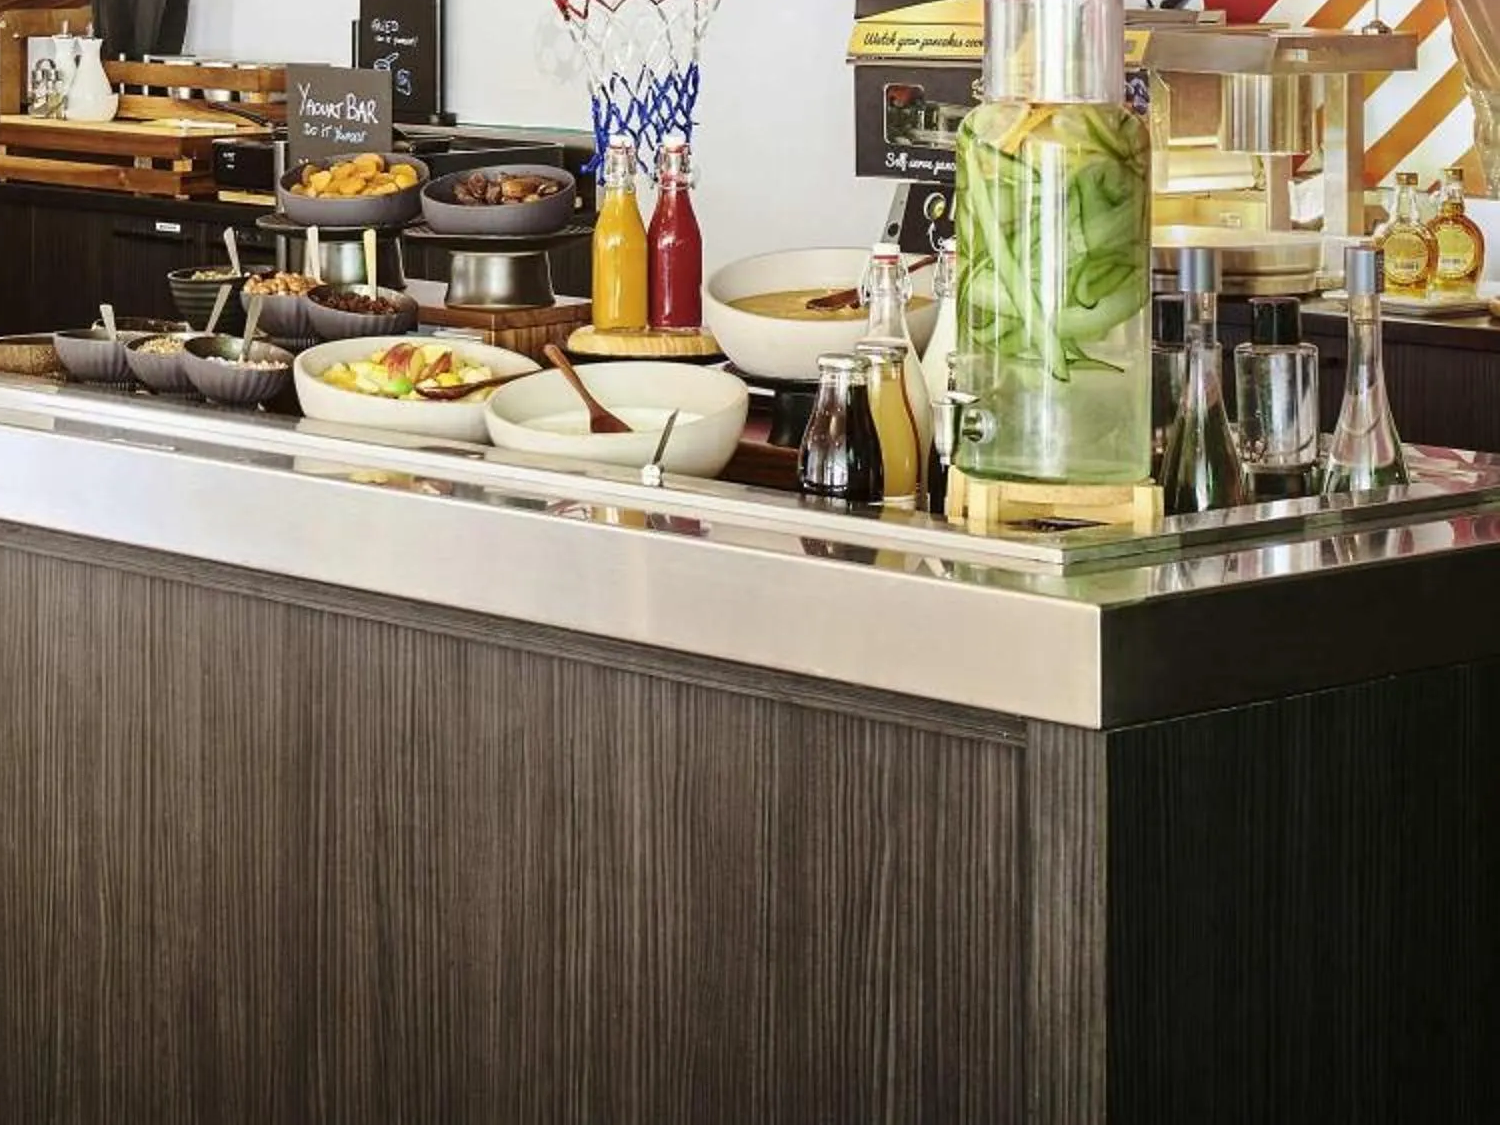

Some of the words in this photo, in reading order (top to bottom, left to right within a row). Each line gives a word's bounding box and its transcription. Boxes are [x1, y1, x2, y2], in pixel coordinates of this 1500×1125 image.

[863, 31, 897, 47] Watch
[897, 38, 920, 51] your
[920, 32, 963, 51] pancakes
[345, 91, 379, 124] BAR
[885, 151, 908, 172] Self
